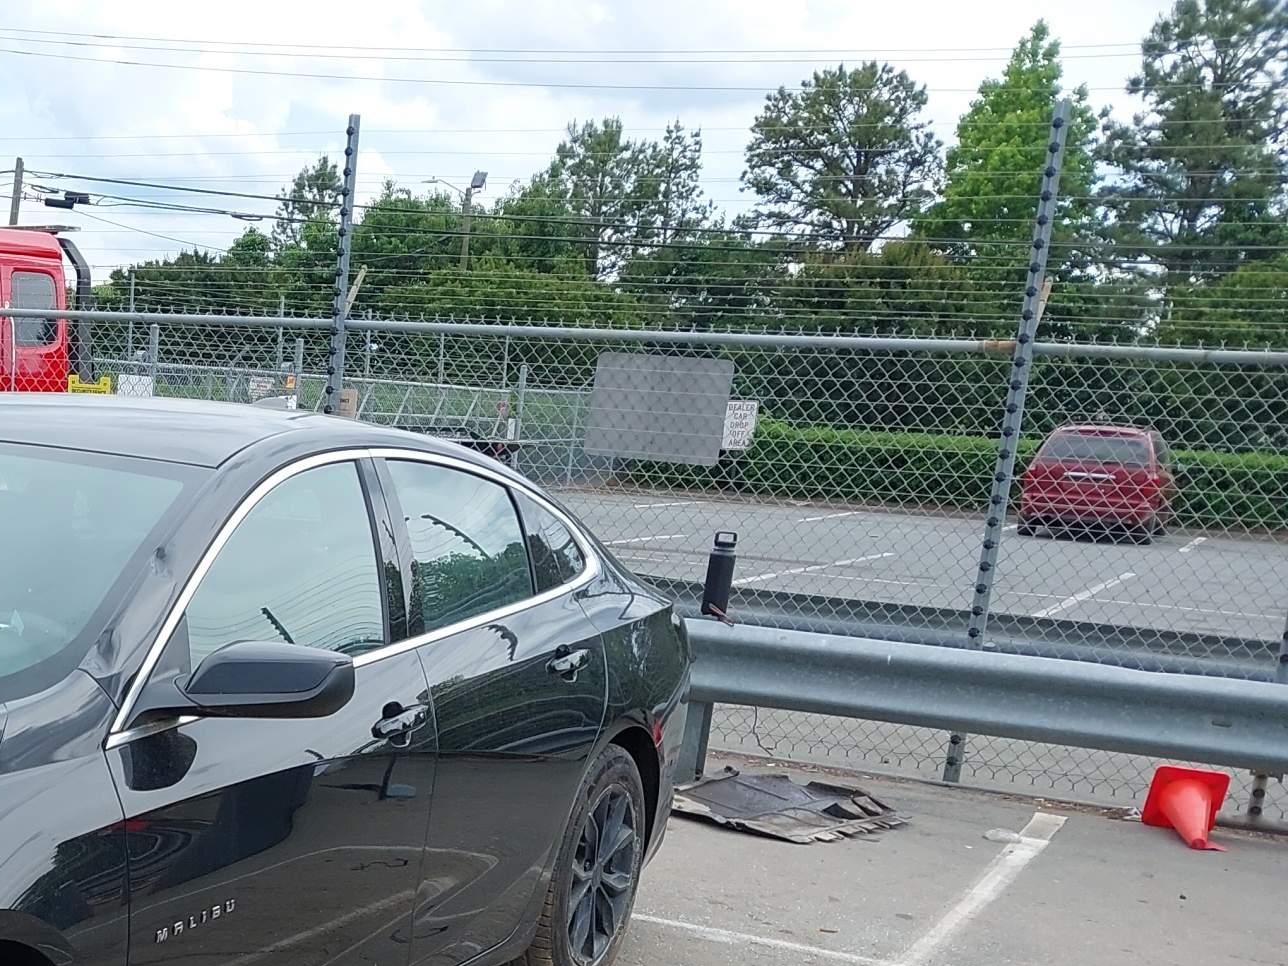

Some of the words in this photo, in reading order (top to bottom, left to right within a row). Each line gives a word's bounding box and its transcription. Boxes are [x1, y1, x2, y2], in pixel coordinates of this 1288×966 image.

[728, 403, 756, 411] DEALER
[733, 412, 748, 420] CAR
[729, 421, 749, 429] DROP
[731, 430, 746, 438] OFF
[728, 439, 746, 447] AREA
[155, 899, 235, 943] MALIBU
